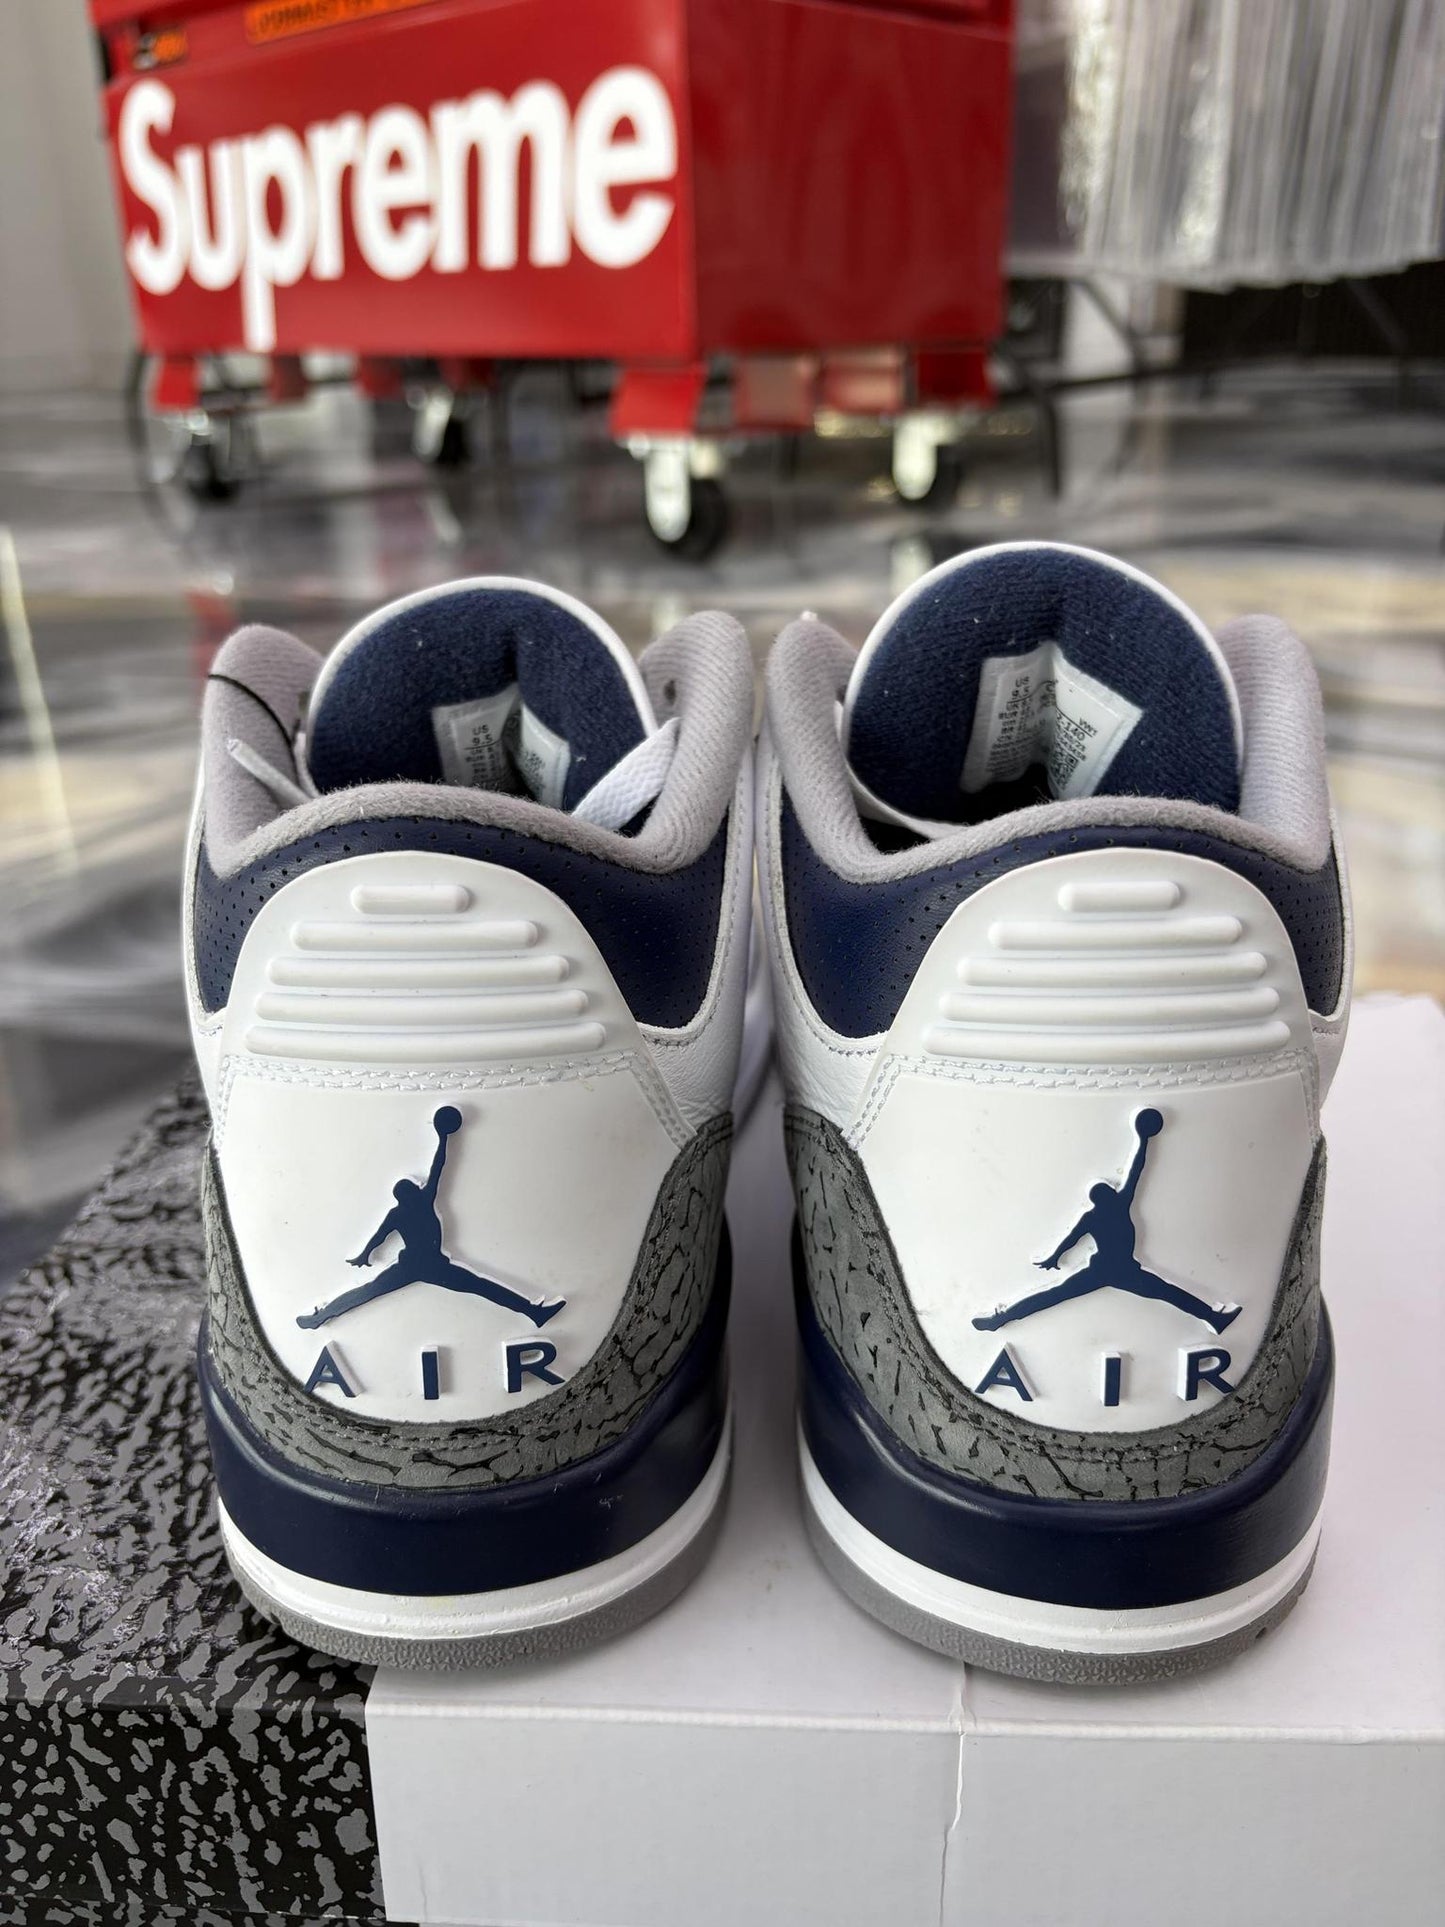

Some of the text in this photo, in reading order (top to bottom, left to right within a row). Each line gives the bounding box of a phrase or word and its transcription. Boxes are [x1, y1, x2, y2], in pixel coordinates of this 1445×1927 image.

[119, 65, 678, 352] Supreme
[302, 1344, 566, 1400] AIR
[974, 1347, 1237, 1407] AIR
